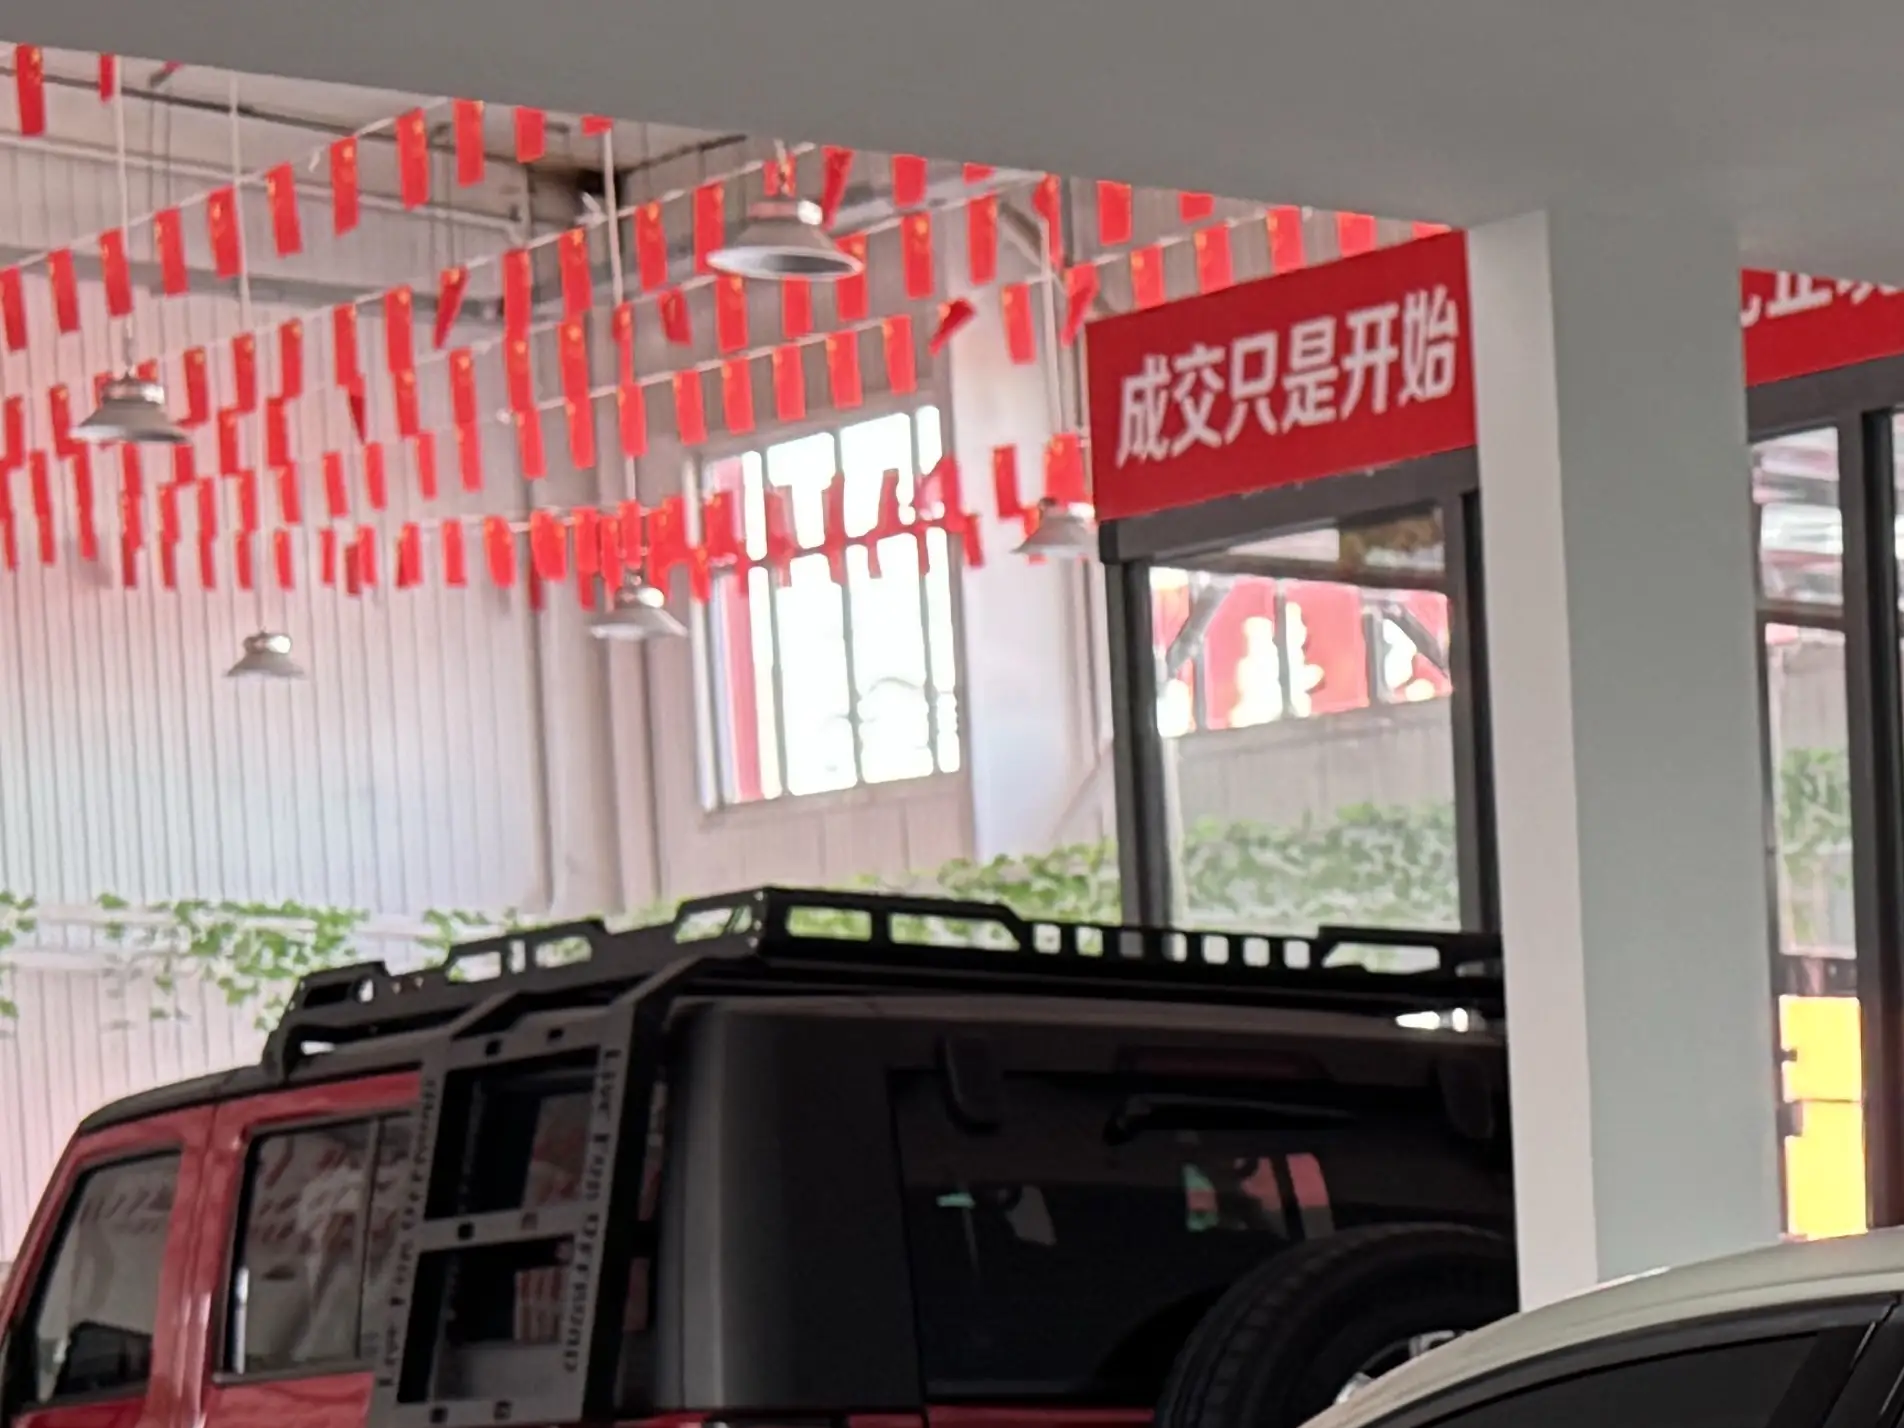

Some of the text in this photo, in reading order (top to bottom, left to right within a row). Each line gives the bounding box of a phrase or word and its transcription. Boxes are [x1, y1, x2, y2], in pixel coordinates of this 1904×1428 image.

[1115, 283, 1460, 469] 成交只是开始
